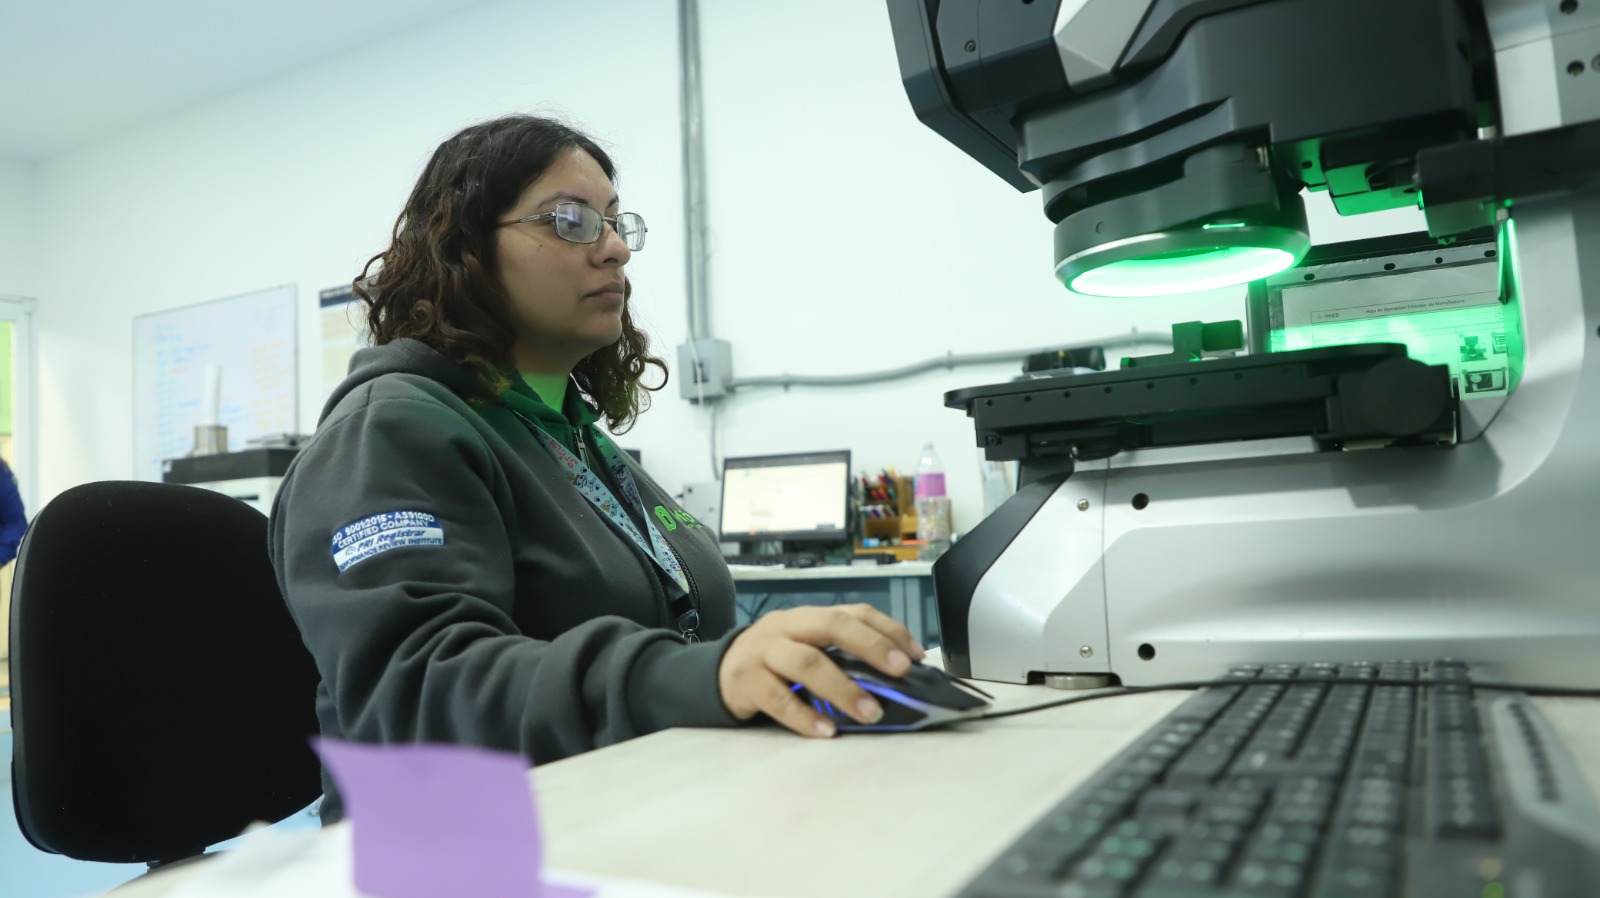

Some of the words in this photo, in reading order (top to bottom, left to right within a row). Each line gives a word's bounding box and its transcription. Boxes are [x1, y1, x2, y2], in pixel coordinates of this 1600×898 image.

[394, 511, 435, 522] AS9100D
[338, 525, 379, 549] CERTIFIED
[380, 518, 428, 530] COMPANY
[357, 537, 374, 551] PRI
[376, 530, 425, 545] Registrar
